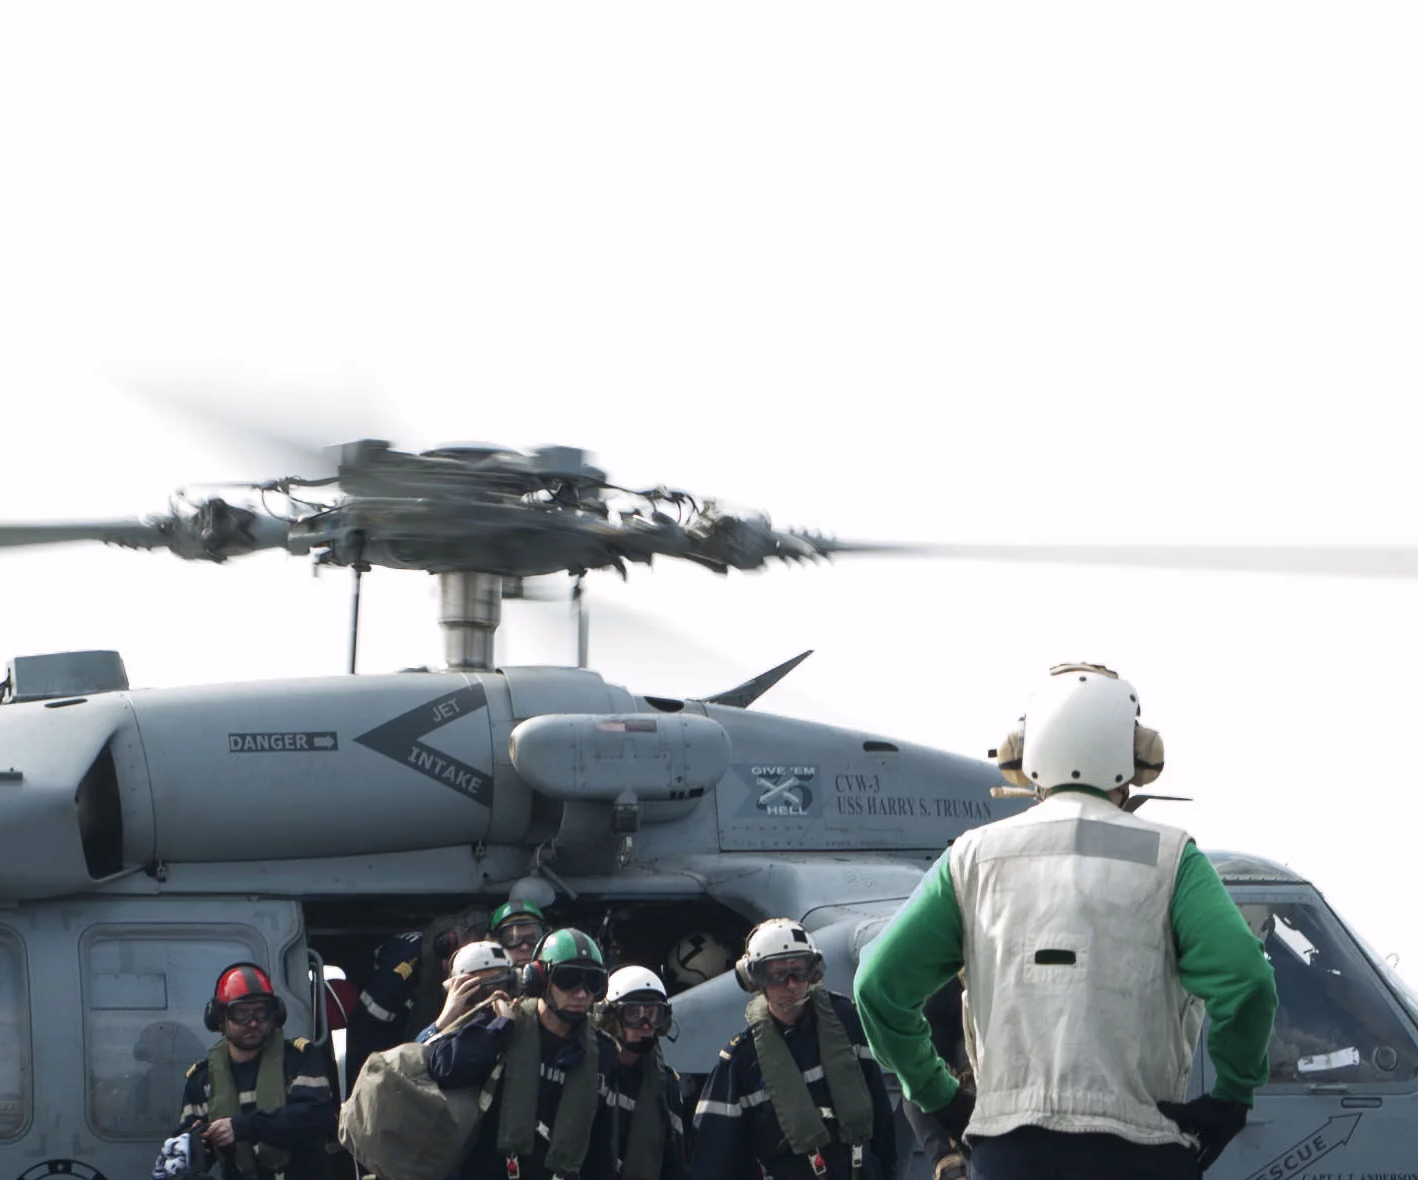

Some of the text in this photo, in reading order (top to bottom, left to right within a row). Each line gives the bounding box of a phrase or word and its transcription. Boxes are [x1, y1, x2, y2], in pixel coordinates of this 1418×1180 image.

[431, 699, 461, 722] JET
[230, 734, 309, 751] DANGER
[407, 746, 483, 794] INTAKE
[751, 766, 787, 776] GIVE
[834, 774, 881, 793] CVW-3
[767, 805, 809, 816] HELL
[837, 796, 992, 820] USS HARRY S. TRUMAN
